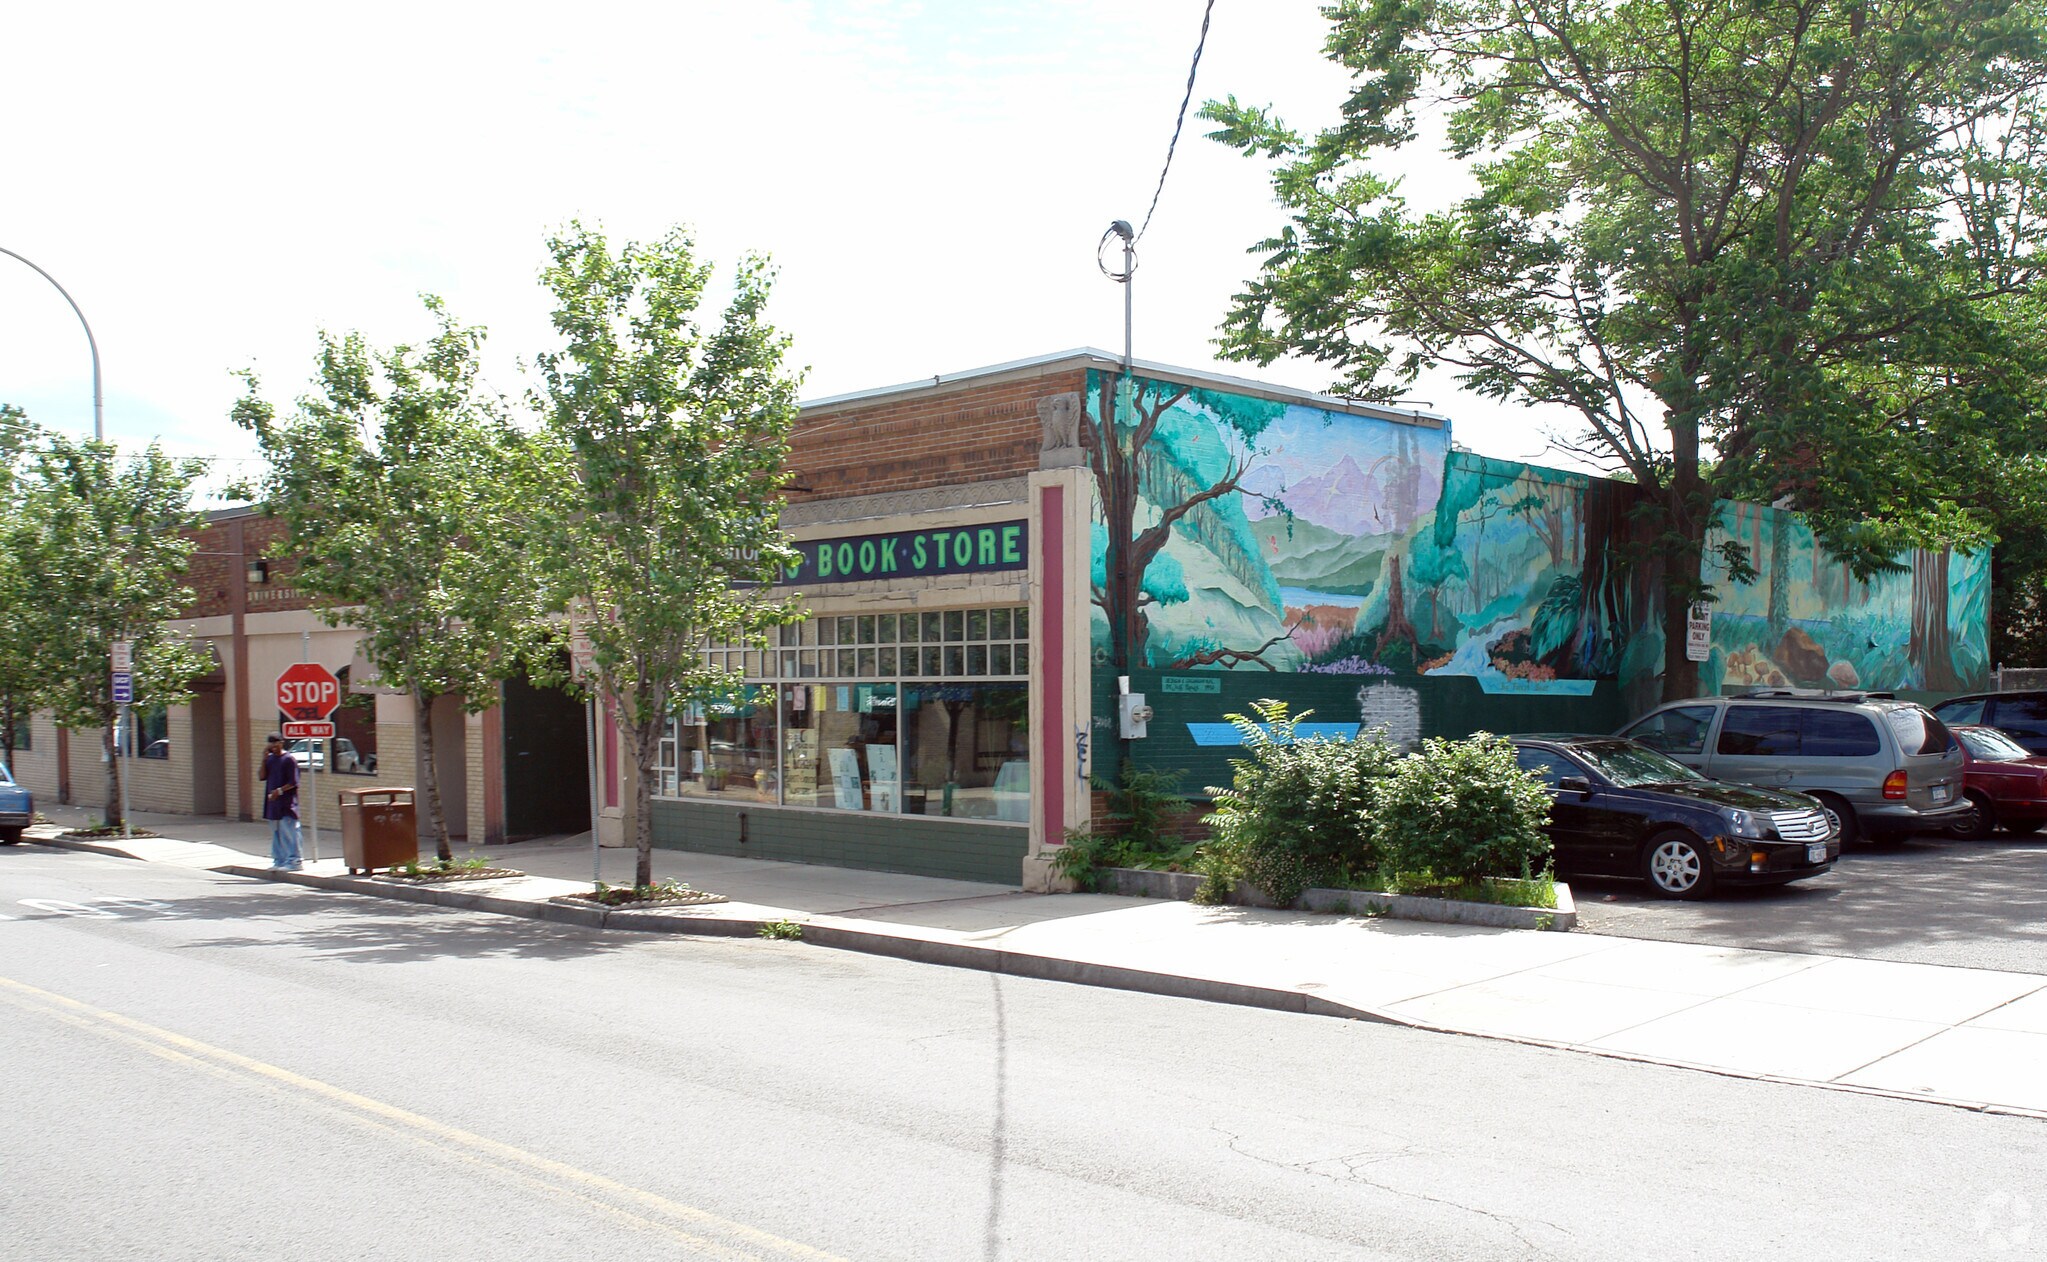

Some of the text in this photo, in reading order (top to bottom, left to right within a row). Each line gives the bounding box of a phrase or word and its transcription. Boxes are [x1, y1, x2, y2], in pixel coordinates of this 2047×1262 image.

[818, 538, 897, 577] BOOK
[912, 526, 1021, 571] STORE
[1689, 621, 1710, 631] PARKING
[1692, 632, 1705, 641] ONLY
[280, 681, 335, 703] STOP
[287, 725, 331, 735] ALL WAY
